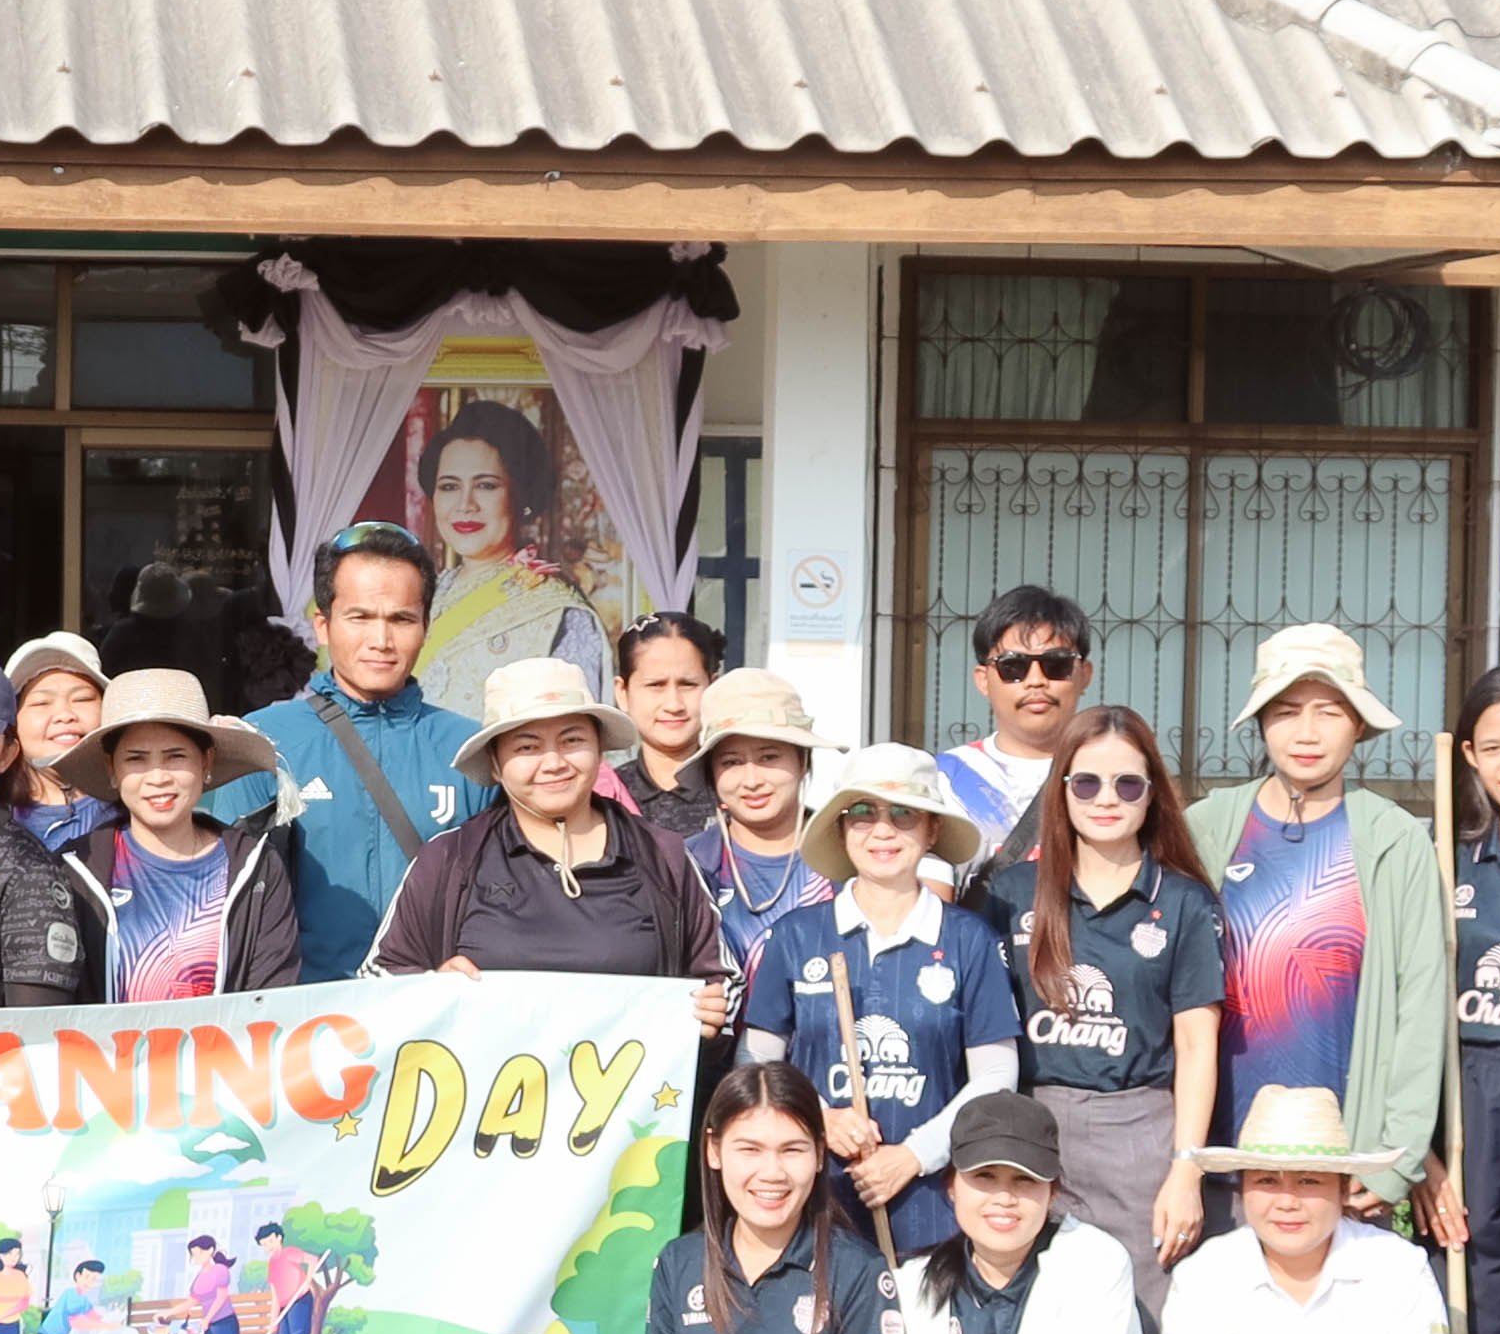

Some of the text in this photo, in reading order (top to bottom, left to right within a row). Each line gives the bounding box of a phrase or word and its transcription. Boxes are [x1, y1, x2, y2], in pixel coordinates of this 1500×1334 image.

[1027, 1009, 1129, 1057] Chang
[828, 1063, 927, 1108] Cang
[369, 1037, 646, 1198] DAY
